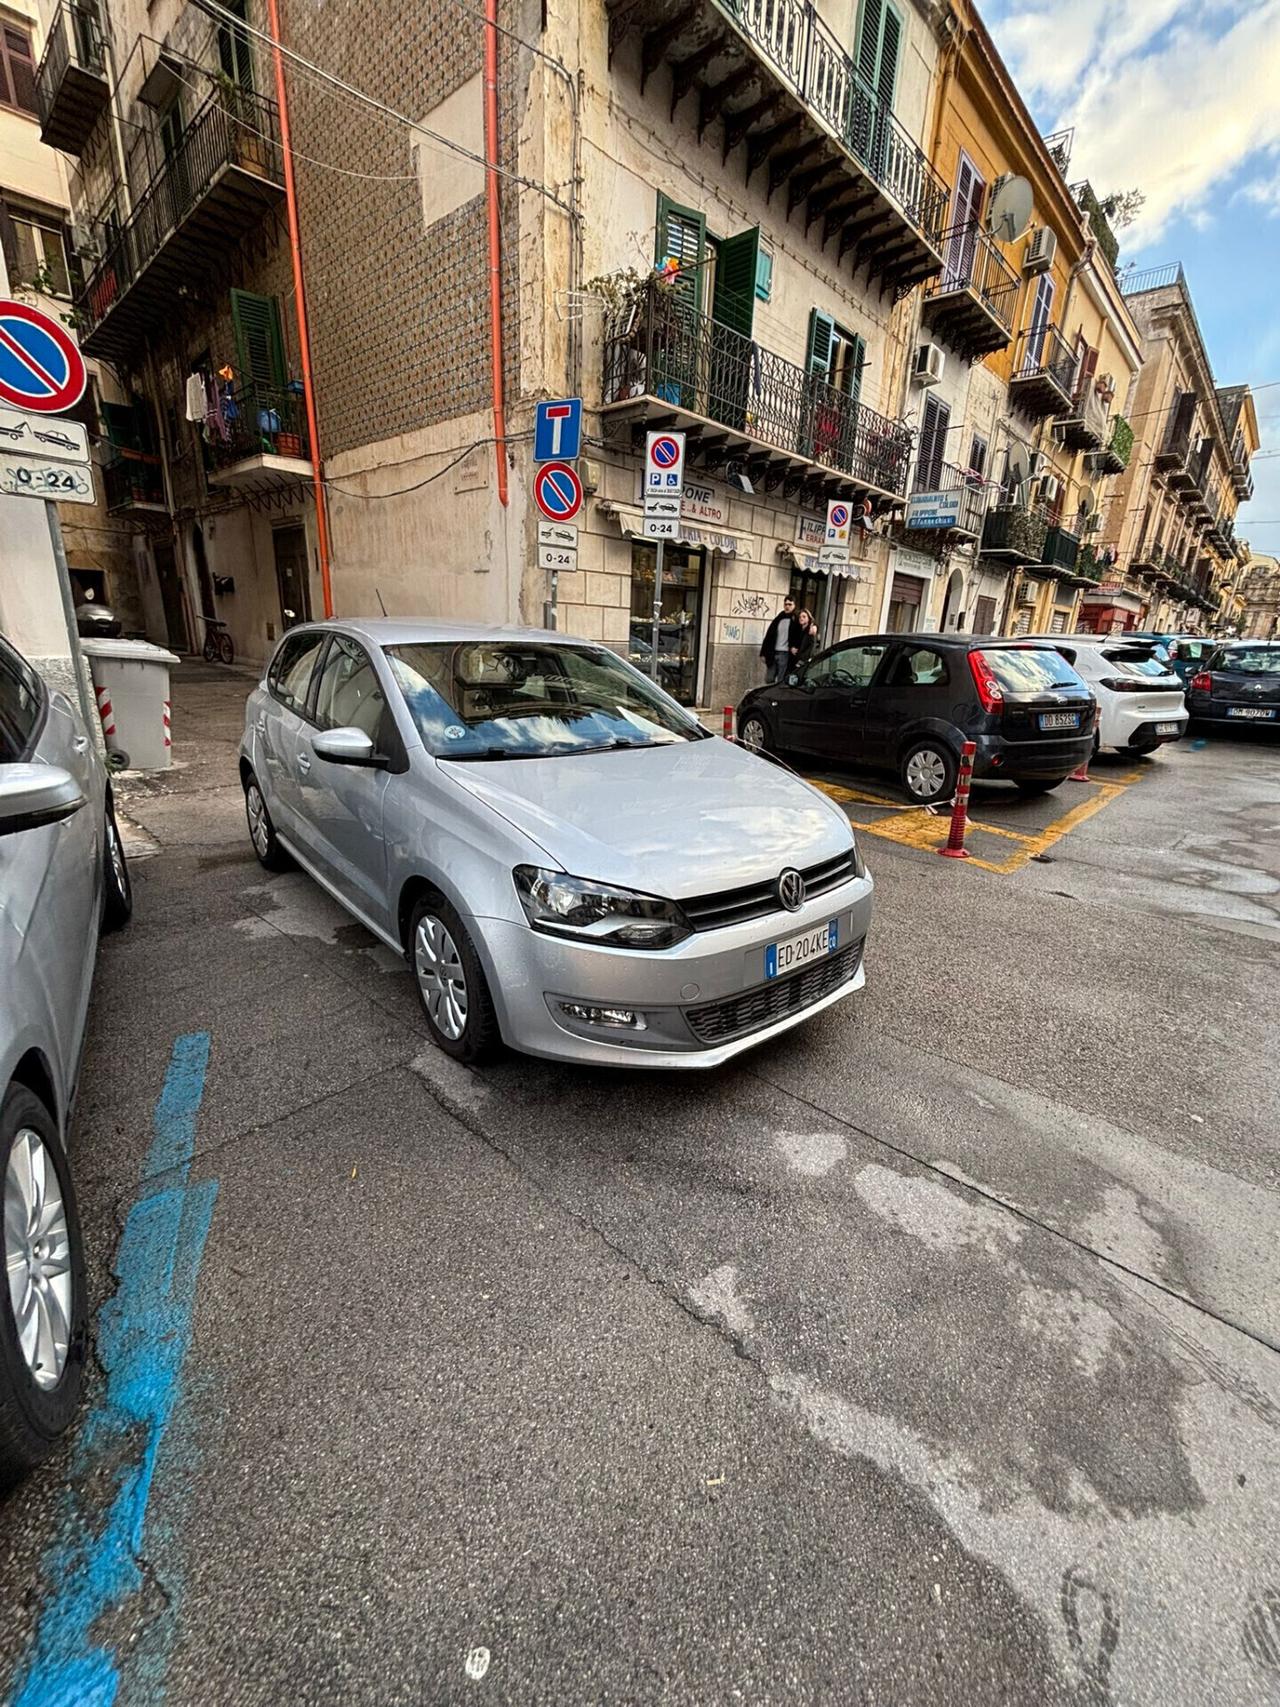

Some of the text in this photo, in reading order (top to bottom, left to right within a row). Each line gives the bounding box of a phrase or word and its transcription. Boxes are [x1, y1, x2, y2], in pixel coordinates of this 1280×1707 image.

[17, 467, 76, 490] 0-24
[652, 473, 660, 485] P
[699, 505, 722, 520] ALTRO
[649, 523, 672, 534] 0-24
[545, 553, 571, 564] 0-24
